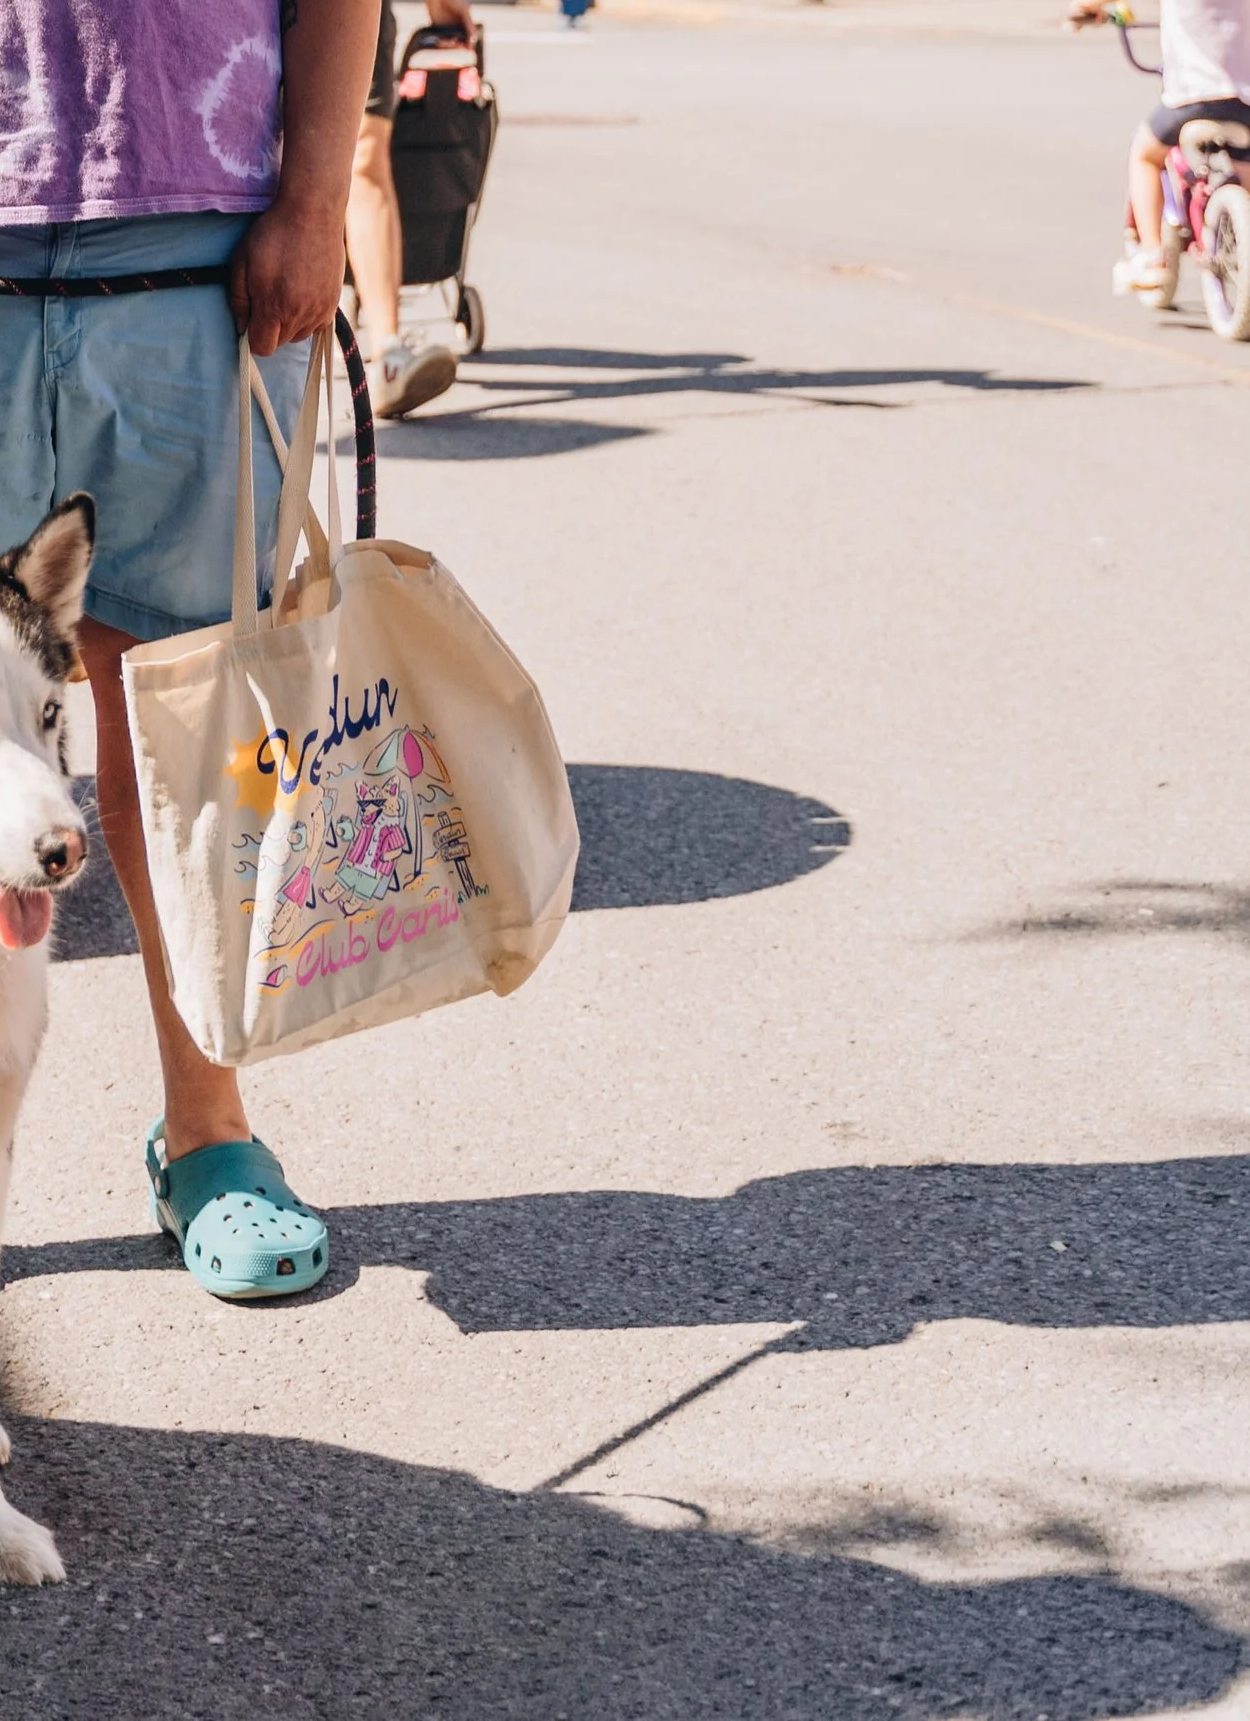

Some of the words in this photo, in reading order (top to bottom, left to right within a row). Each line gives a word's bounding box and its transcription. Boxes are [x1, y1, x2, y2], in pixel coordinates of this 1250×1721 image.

[257, 674, 398, 794] Vedun
[296, 920, 371, 987] Club
[376, 887, 459, 952] Canis
